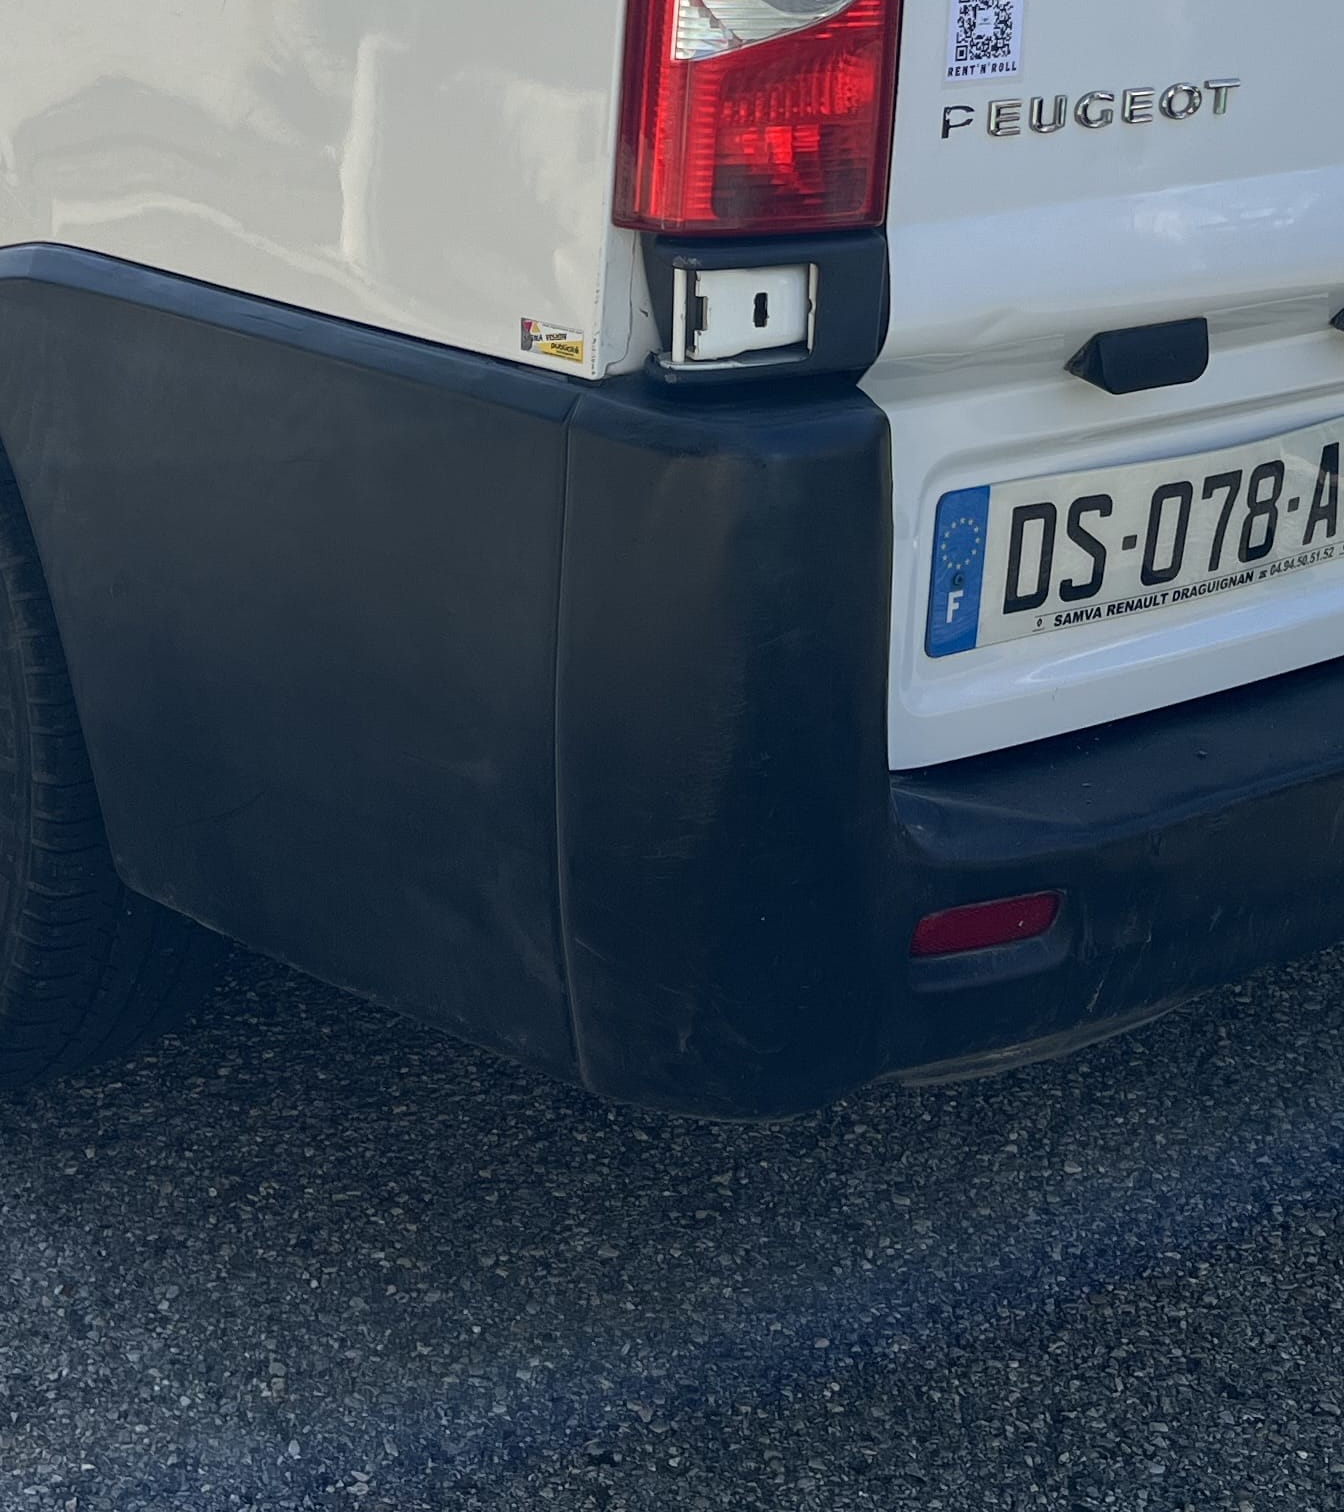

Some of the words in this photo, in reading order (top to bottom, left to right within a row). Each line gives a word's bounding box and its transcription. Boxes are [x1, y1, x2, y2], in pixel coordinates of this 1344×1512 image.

[947, 61, 1017, 77] RENT'N'ROLL
[940, 77, 1241, 139] PEUGEOT
[945, 589, 964, 625] F
[1054, 607, 1102, 627] SAMVA
[1106, 592, 1169, 617] RENAULT
[1172, 570, 1255, 603] DRAGUIGNAN
[1269, 546, 1335, 577] 04.94.50.51.52
